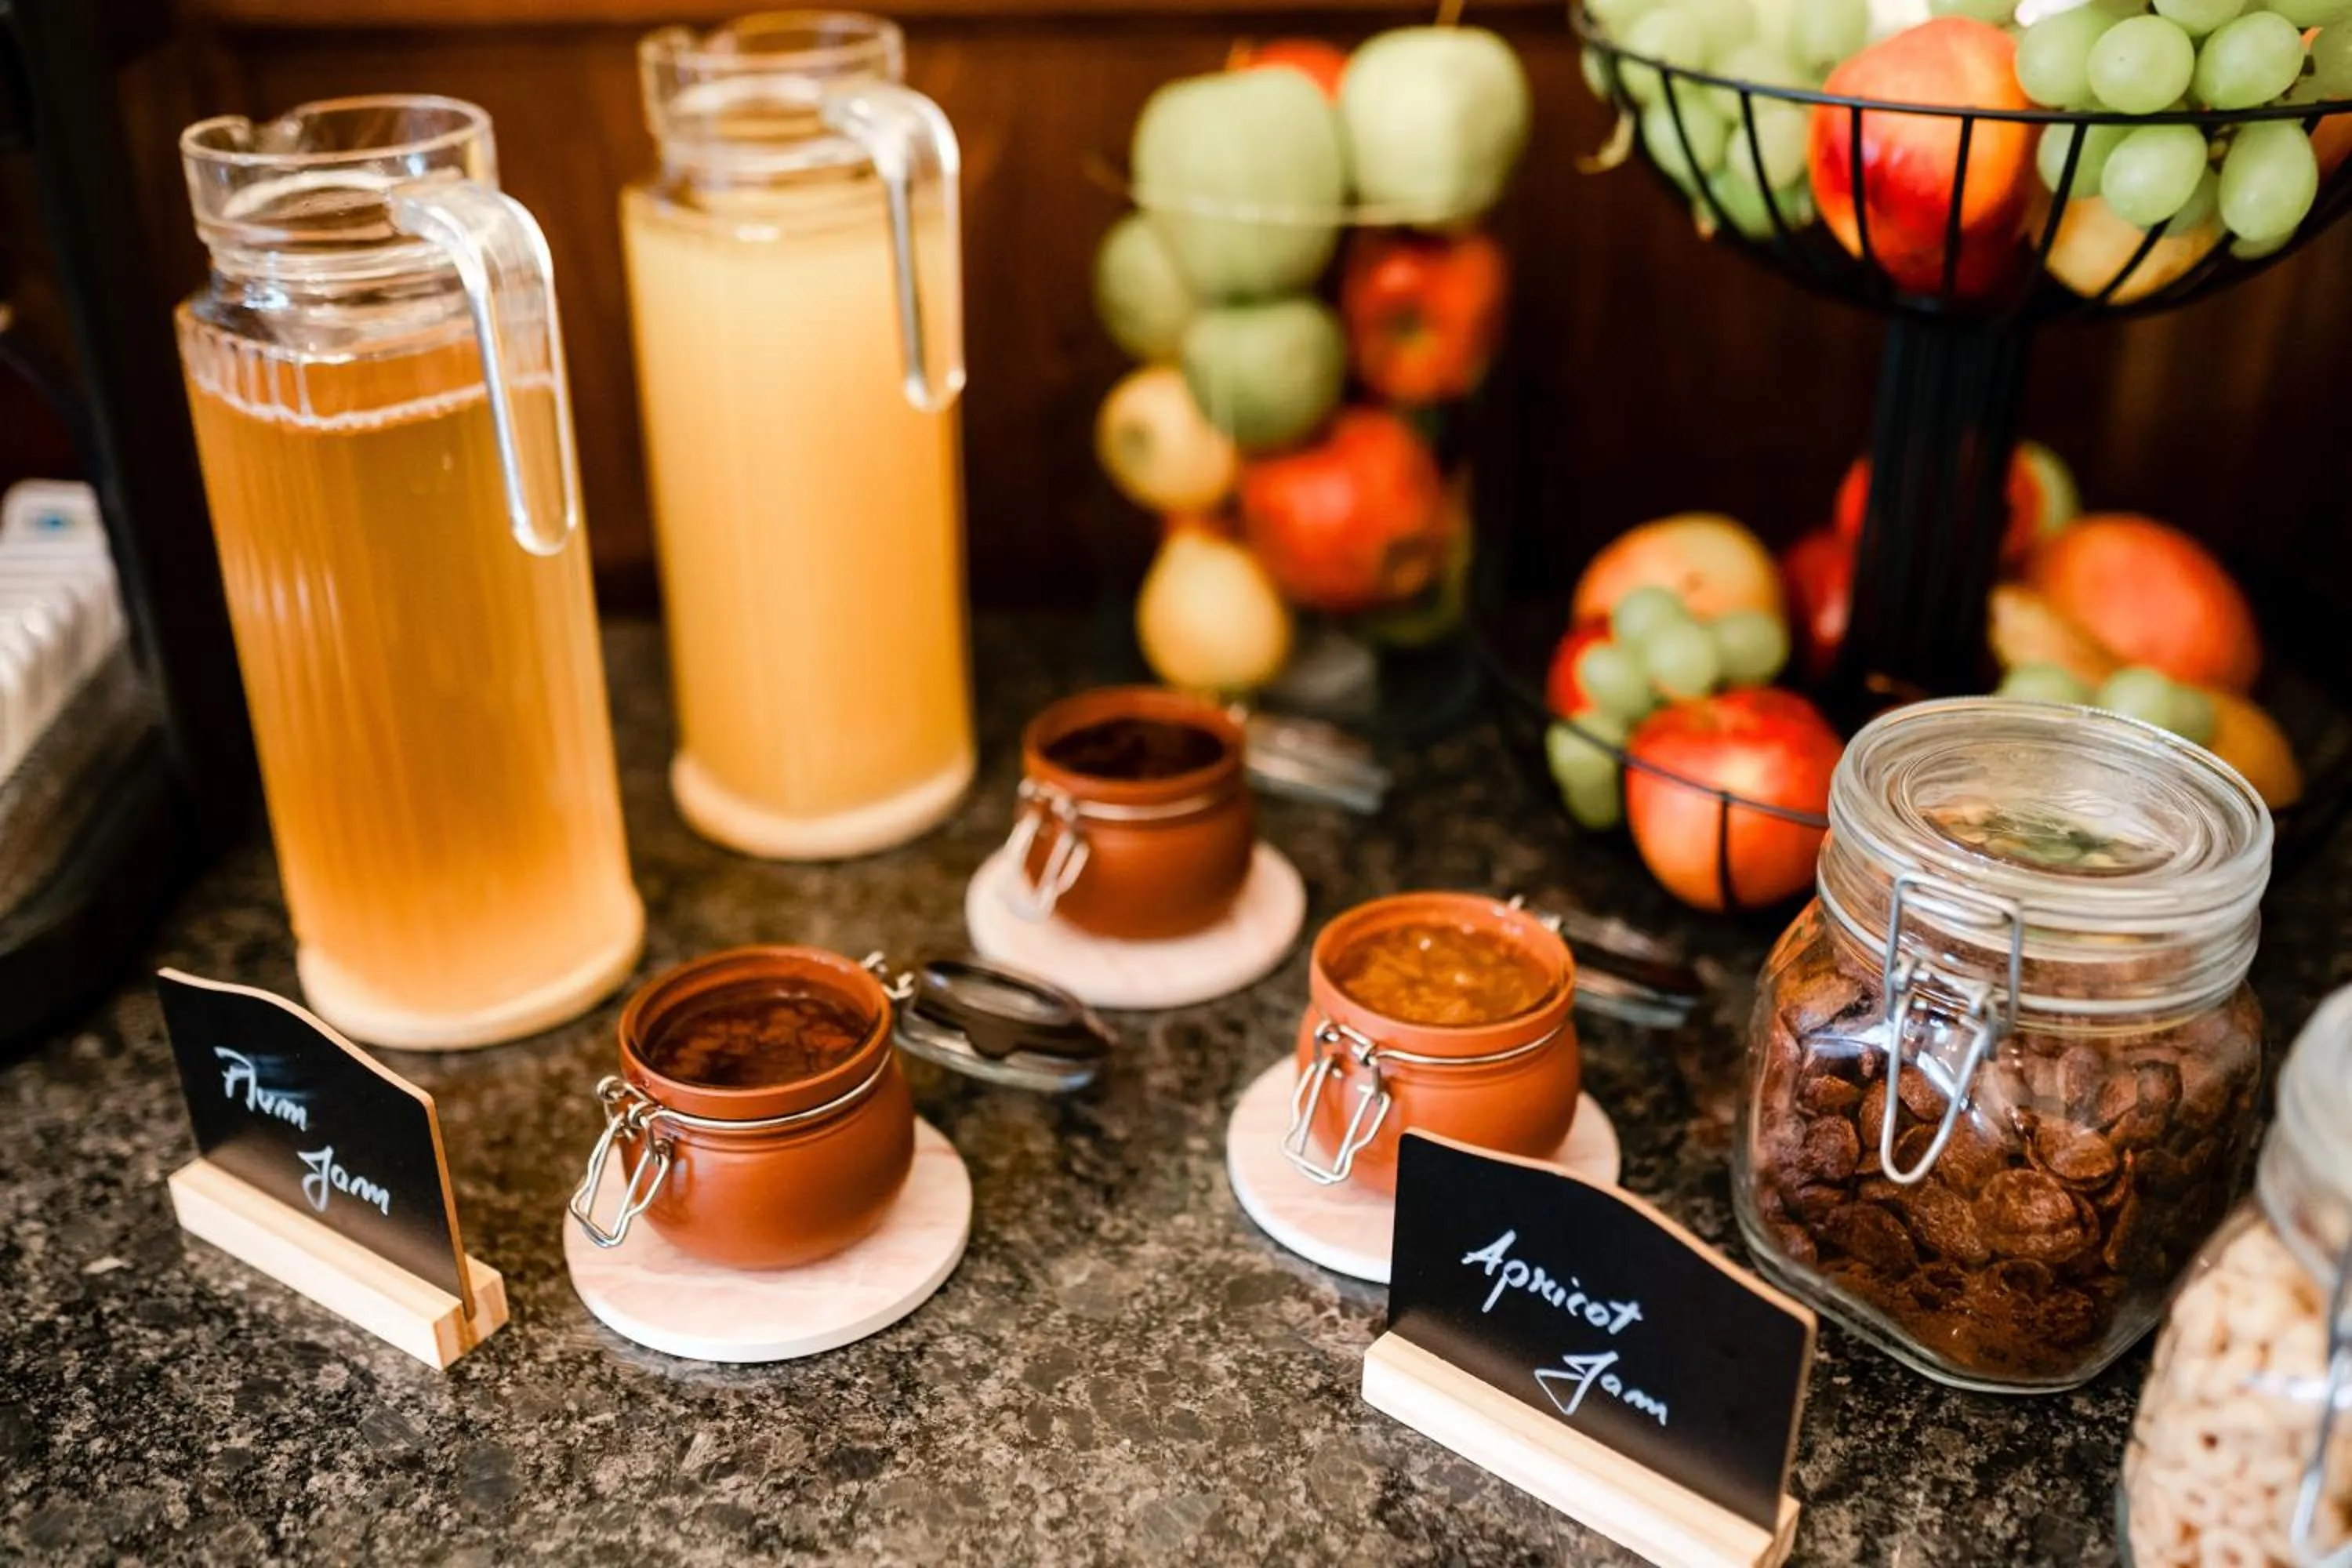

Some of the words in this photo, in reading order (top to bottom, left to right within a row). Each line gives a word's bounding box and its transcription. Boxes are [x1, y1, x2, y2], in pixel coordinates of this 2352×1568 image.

[296, 1145, 390, 1216] Jam
[1461, 1229, 1644, 1334] Apricot
[1534, 1350, 1668, 1426] Jam
